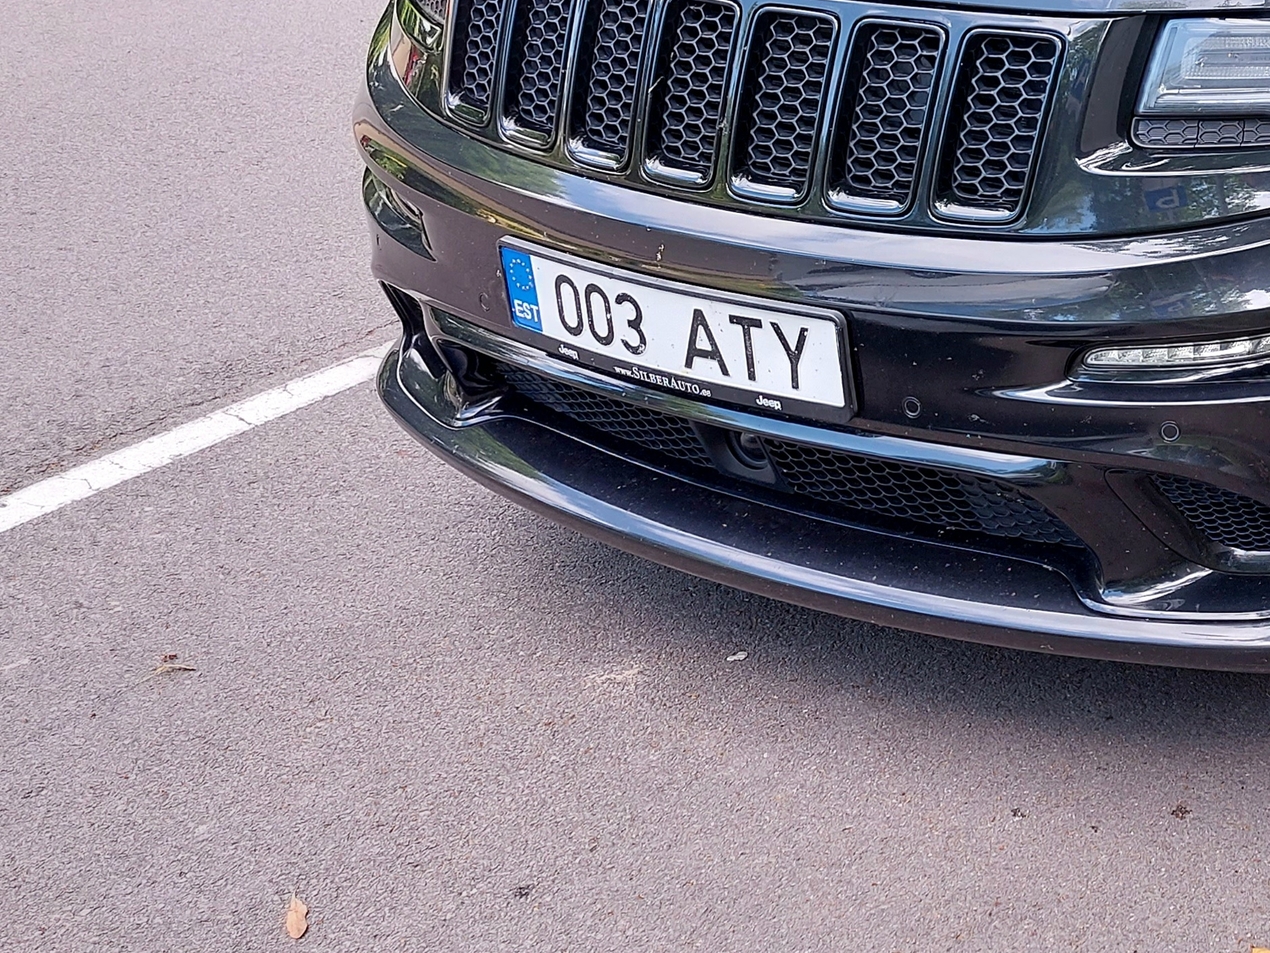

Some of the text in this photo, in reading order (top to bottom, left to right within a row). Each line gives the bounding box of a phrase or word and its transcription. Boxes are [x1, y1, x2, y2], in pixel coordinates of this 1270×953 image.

[513, 298, 540, 324] EST
[554, 273, 810, 391] 003 ATY
[558, 344, 579, 361] Jeep
[756, 395, 783, 411] Jeep
